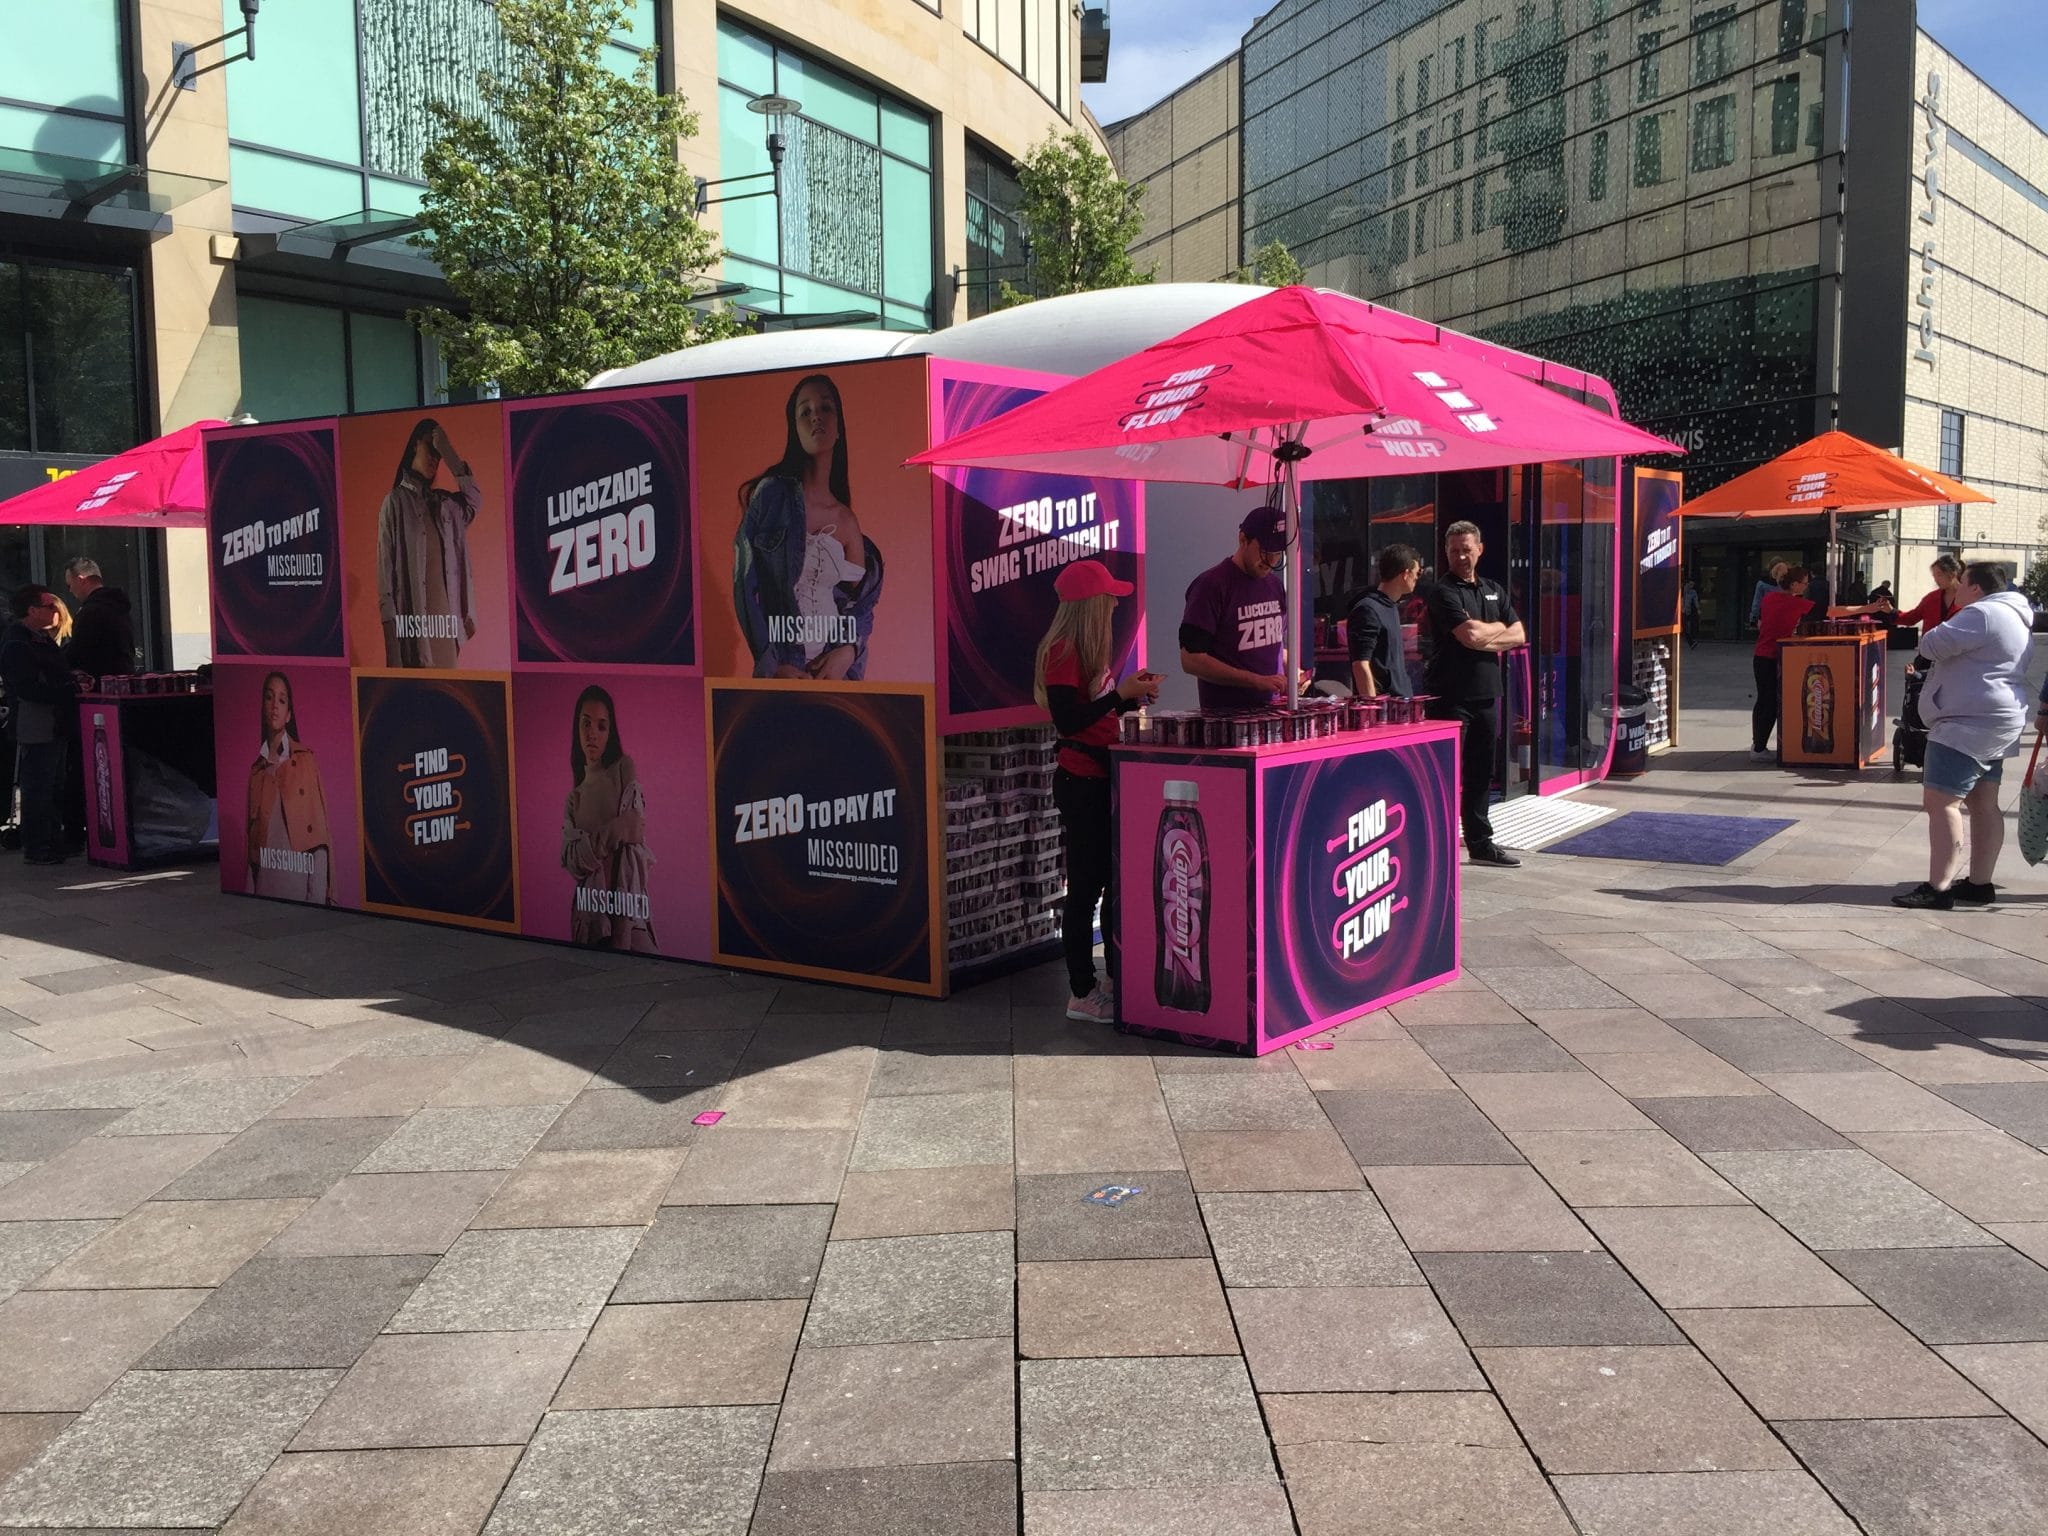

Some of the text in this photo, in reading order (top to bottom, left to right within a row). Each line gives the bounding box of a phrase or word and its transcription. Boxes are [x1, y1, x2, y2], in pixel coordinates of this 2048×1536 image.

[1914, 240, 1937, 373] John
[1162, 364, 1216, 388] FIND
[1144, 383, 1202, 409] YOUR
[1122, 403, 1189, 433] FLOW
[1795, 481, 1826, 493] YOUR
[1800, 471, 1827, 482] FIND
[547, 461, 653, 527] LUCOZADE
[1790, 491, 1825, 503] FLOW
[222, 507, 320, 567] ZERO TO PAY AT
[998, 492, 1097, 549] ZERO TO IT
[267, 553, 323, 577] MISSGUIDED
[548, 503, 656, 595] ZERO
[971, 519, 1120, 593] SWAG THROUGH IT
[395, 614, 458, 639] MISSGUIDED
[768, 615, 857, 644] MISSGUIDED
[1238, 615, 1283, 651] ZERO
[415, 747, 449, 777] FIND
[413, 781, 453, 811] YOUR
[413, 815, 456, 846] FLOW
[735, 788, 896, 843] ZERO TO PAY AT
[1348, 799, 1387, 853] FIND
[260, 847, 314, 875] MISSGUIDED
[807, 837, 899, 874] MISSGUIDED
[1345, 847, 1391, 905] YOUR
[576, 886, 649, 920] MISSGUIDED
[1173, 857, 1189, 958] Lucozade
[1343, 895, 1392, 960] FLOW
